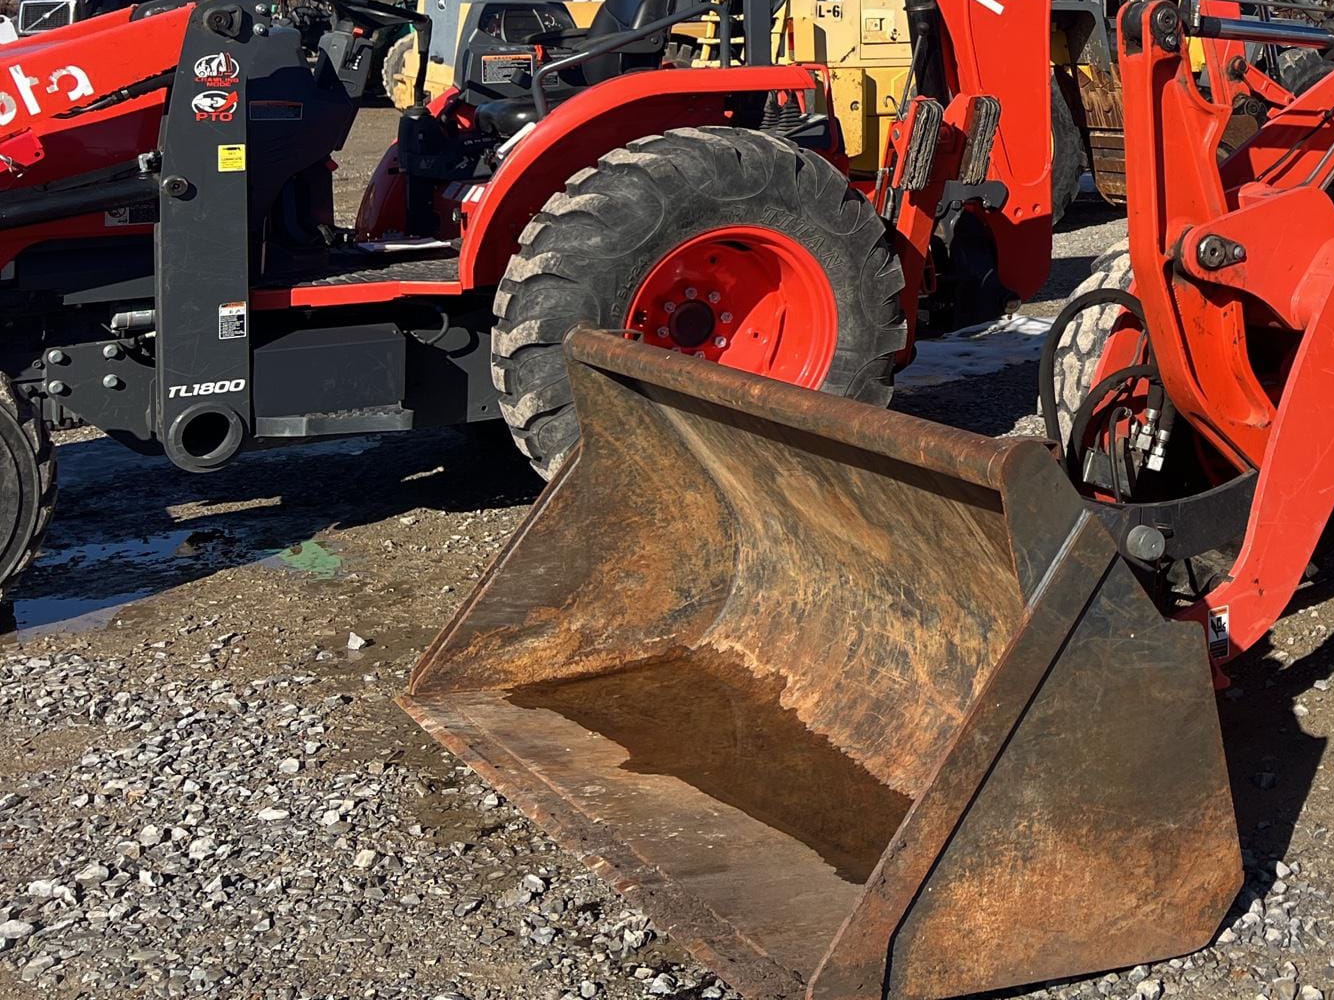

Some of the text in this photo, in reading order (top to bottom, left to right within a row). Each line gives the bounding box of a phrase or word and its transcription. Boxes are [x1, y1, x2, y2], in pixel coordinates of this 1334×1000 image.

[818, 4, 841, 18] L-6
[195, 112, 233, 121] PTO
[168, 379, 246, 399] TL1800
